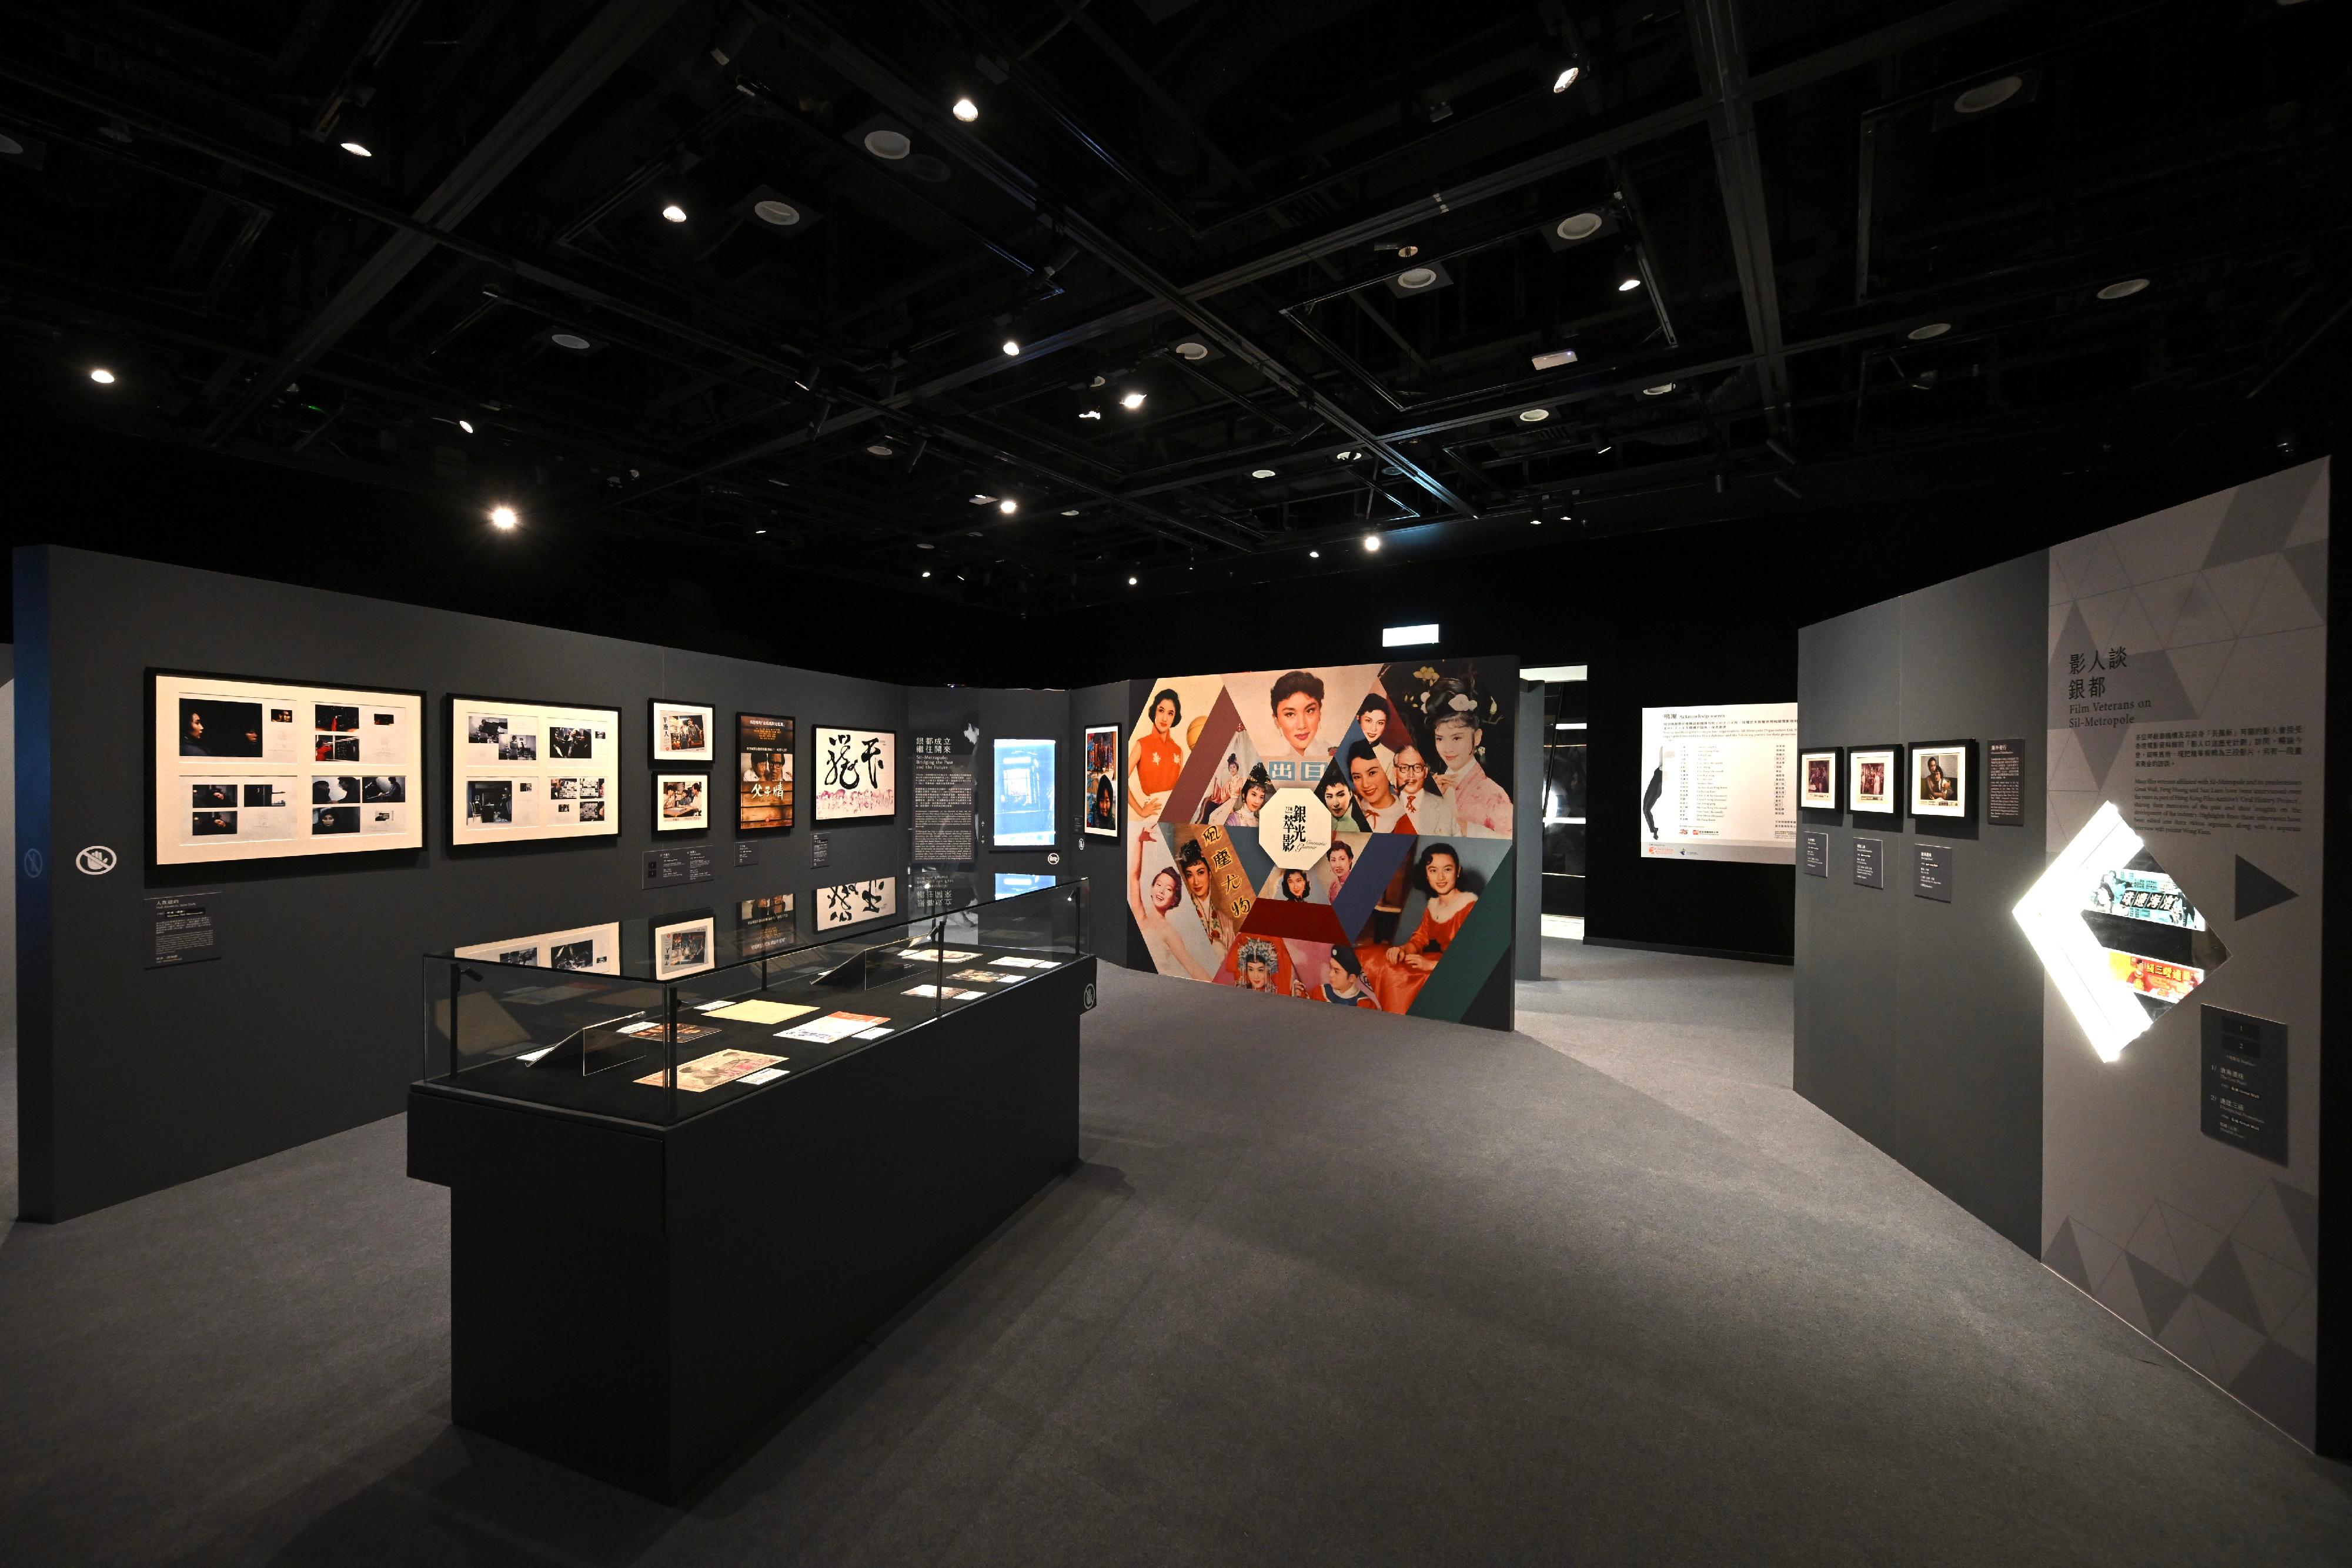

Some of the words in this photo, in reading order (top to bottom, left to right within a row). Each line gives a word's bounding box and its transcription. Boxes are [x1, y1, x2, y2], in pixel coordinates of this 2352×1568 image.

[2069, 646, 2128, 675] 影人談
[2068, 676, 2106, 700] 銀都
[2069, 703, 2089, 714] Film
[2092, 700, 2134, 712] Veterans
[2137, 699, 2151, 708] on
[2069, 714, 2134, 728] Sil-Metropole
[916, 745, 951, 754] 繼往開來
[751, 782, 784, 800] 父子情
[1295, 843, 1317, 852] Glamour
[2211, 1064, 2217, 1072] 1/
